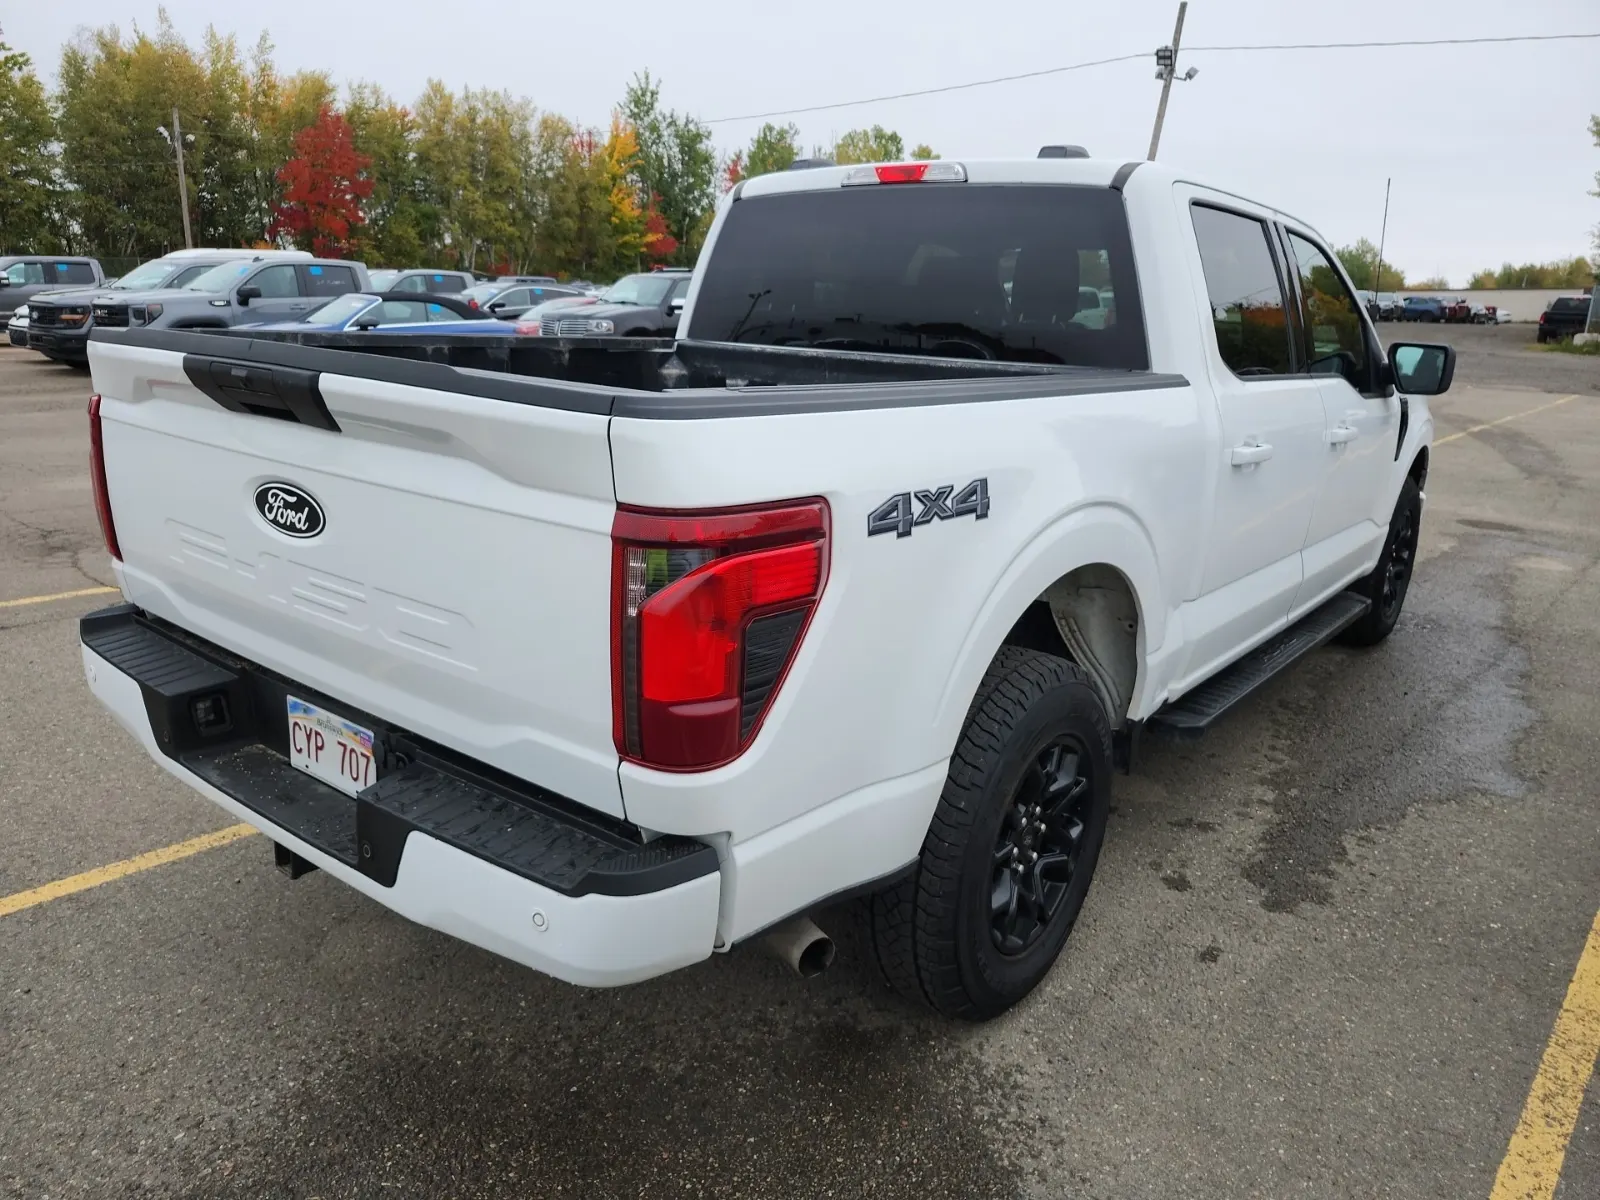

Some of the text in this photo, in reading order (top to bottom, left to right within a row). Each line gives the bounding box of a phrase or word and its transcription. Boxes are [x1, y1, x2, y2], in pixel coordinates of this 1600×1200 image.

[264, 488, 309, 531] Ford
[292, 720, 325, 762] CYP
[336, 740, 371, 787] 707
